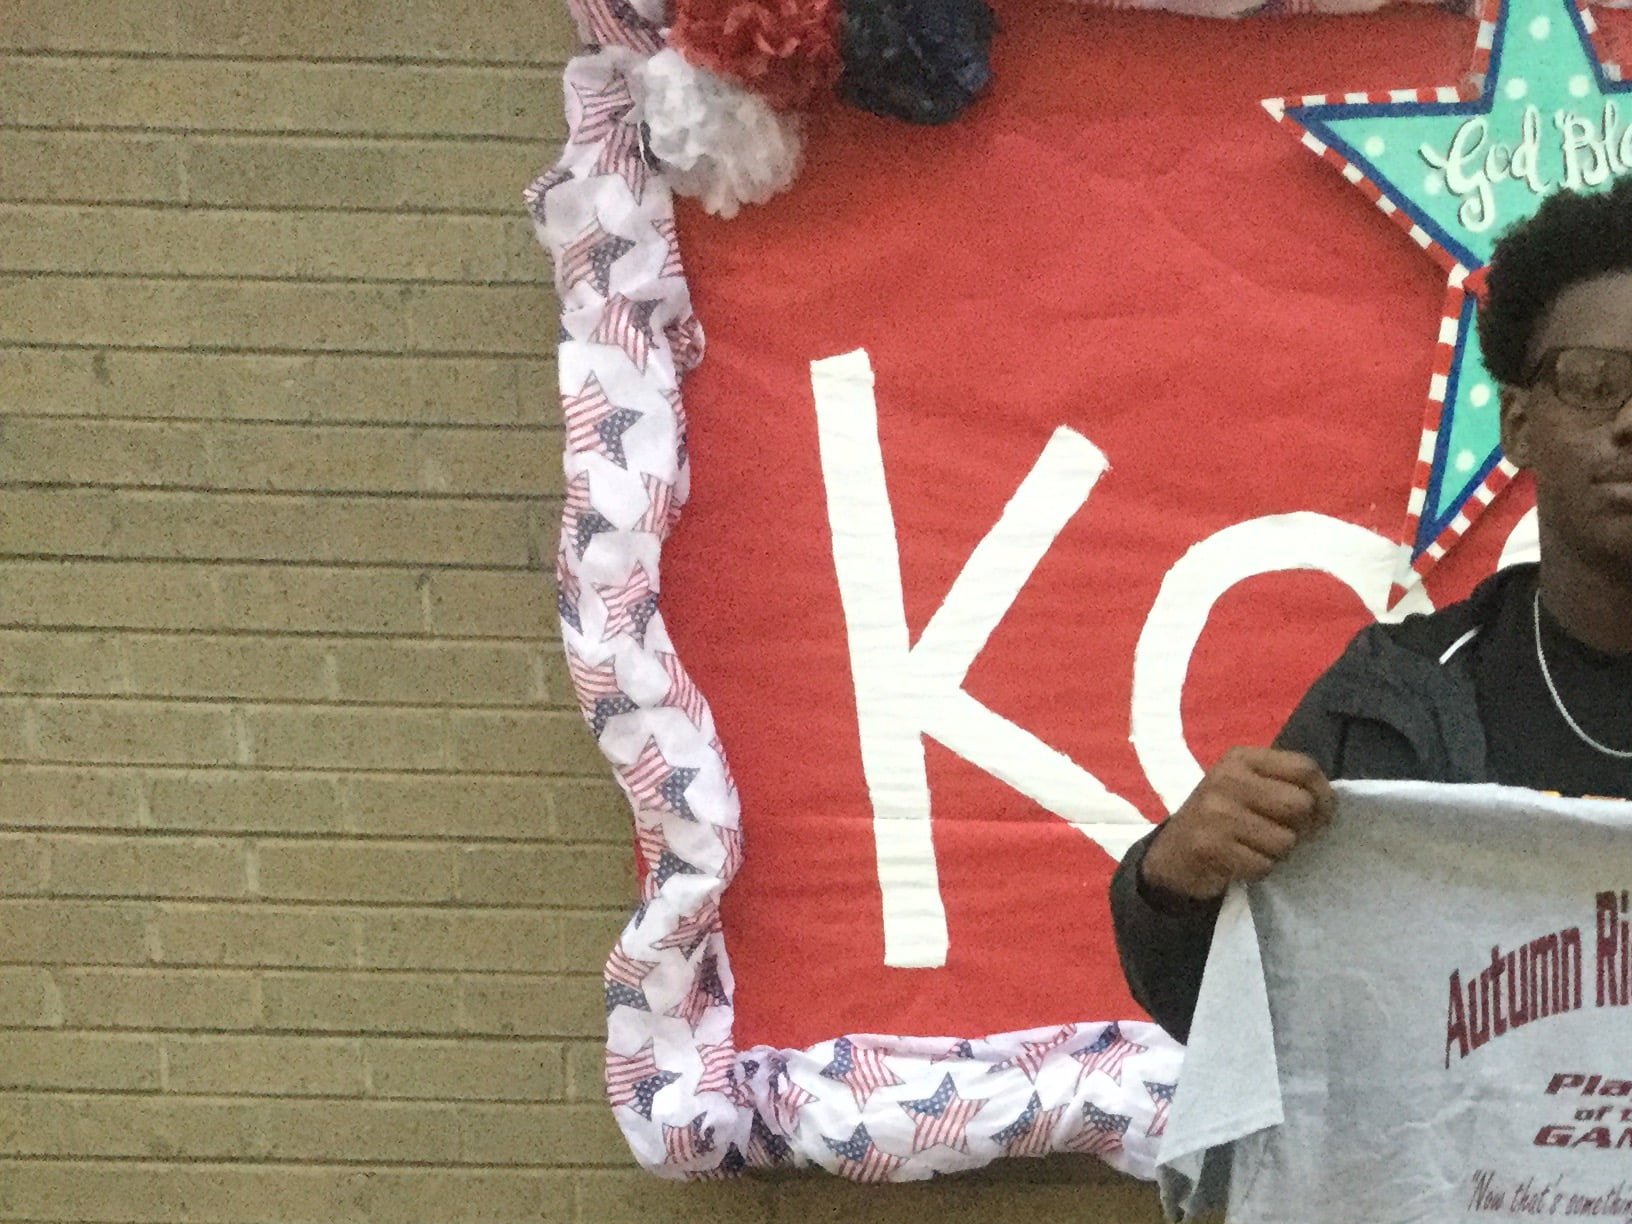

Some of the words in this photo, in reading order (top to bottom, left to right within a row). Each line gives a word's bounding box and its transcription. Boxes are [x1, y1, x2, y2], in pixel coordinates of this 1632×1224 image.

[1419, 103, 1549, 233] God
[1444, 926, 1582, 1070] Autumn
[1573, 1105, 1613, 1122] of
